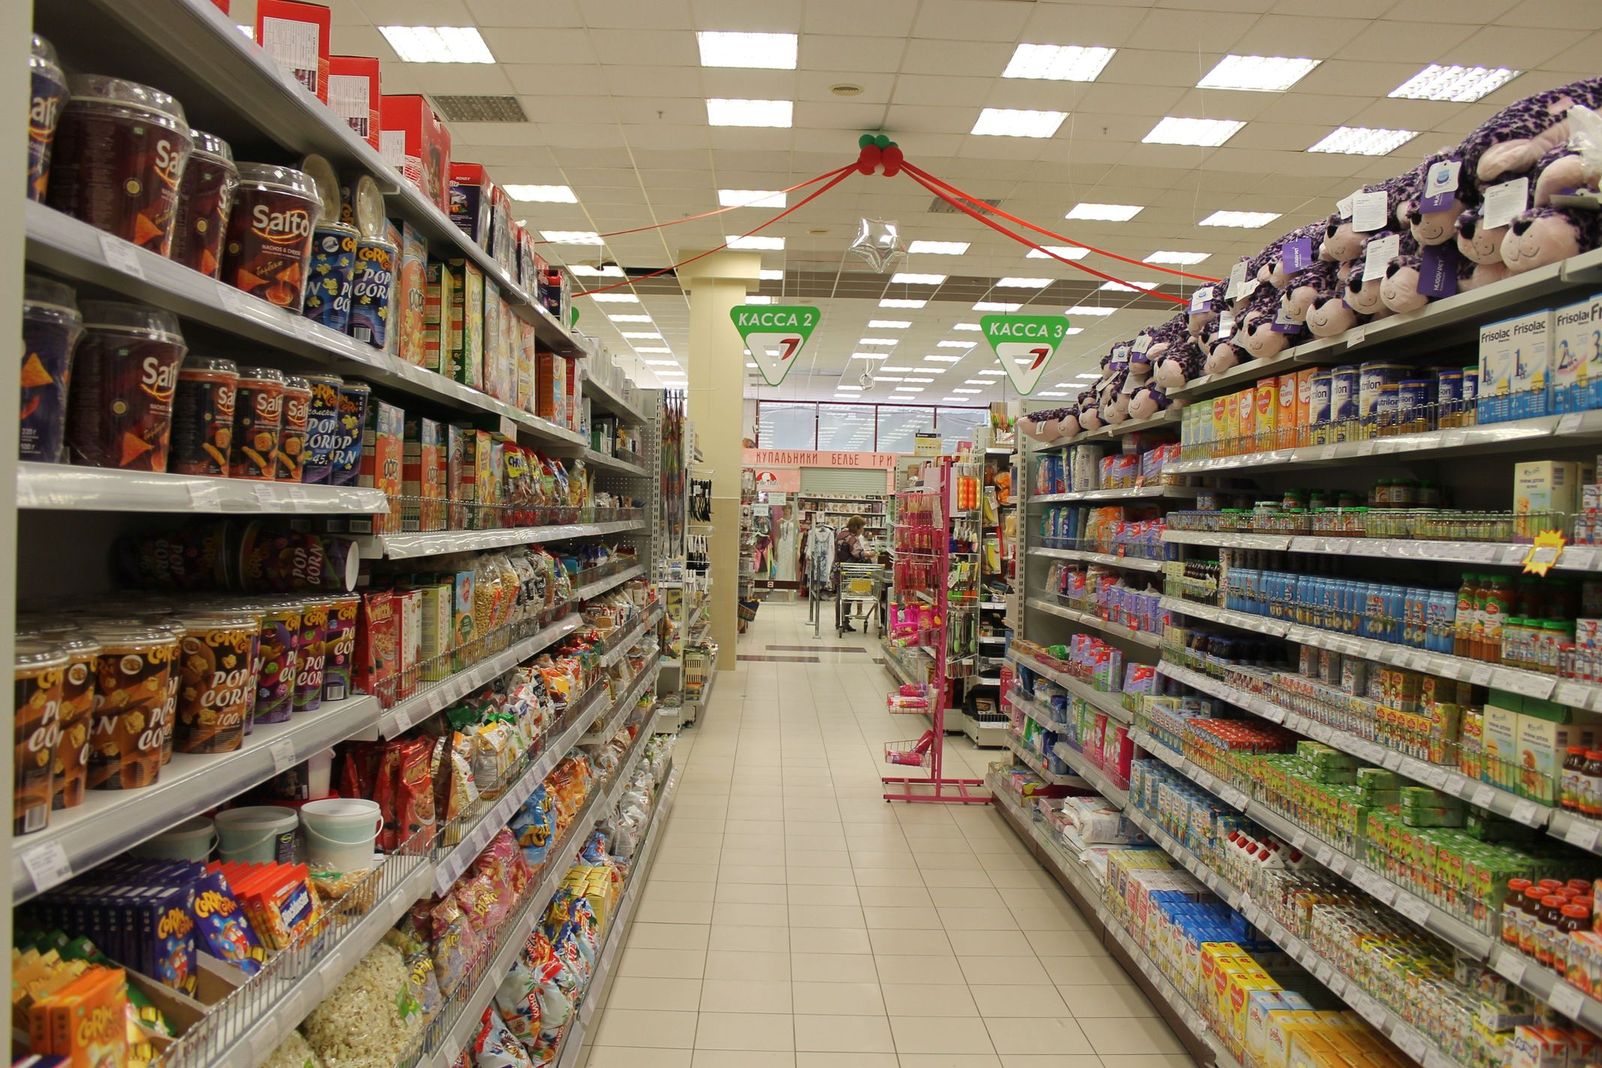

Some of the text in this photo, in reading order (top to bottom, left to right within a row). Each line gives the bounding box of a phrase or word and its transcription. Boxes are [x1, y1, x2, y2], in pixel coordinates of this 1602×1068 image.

[252, 204, 310, 237] Salto
[738, 312, 812, 327] КАССА 2
[989, 322, 1063, 338] КАССА 3
[1480, 328, 1510, 343] Frisolac
[1513, 320, 1546, 336] Frisolac
[756, 451, 818, 465] КУПАЛЬНИКИ
[831, 453, 860, 466] БЕЛЬЕ
[293, 547, 307, 579] POP
[307, 543, 323, 585] CORN
[211, 668, 248, 689] POP
